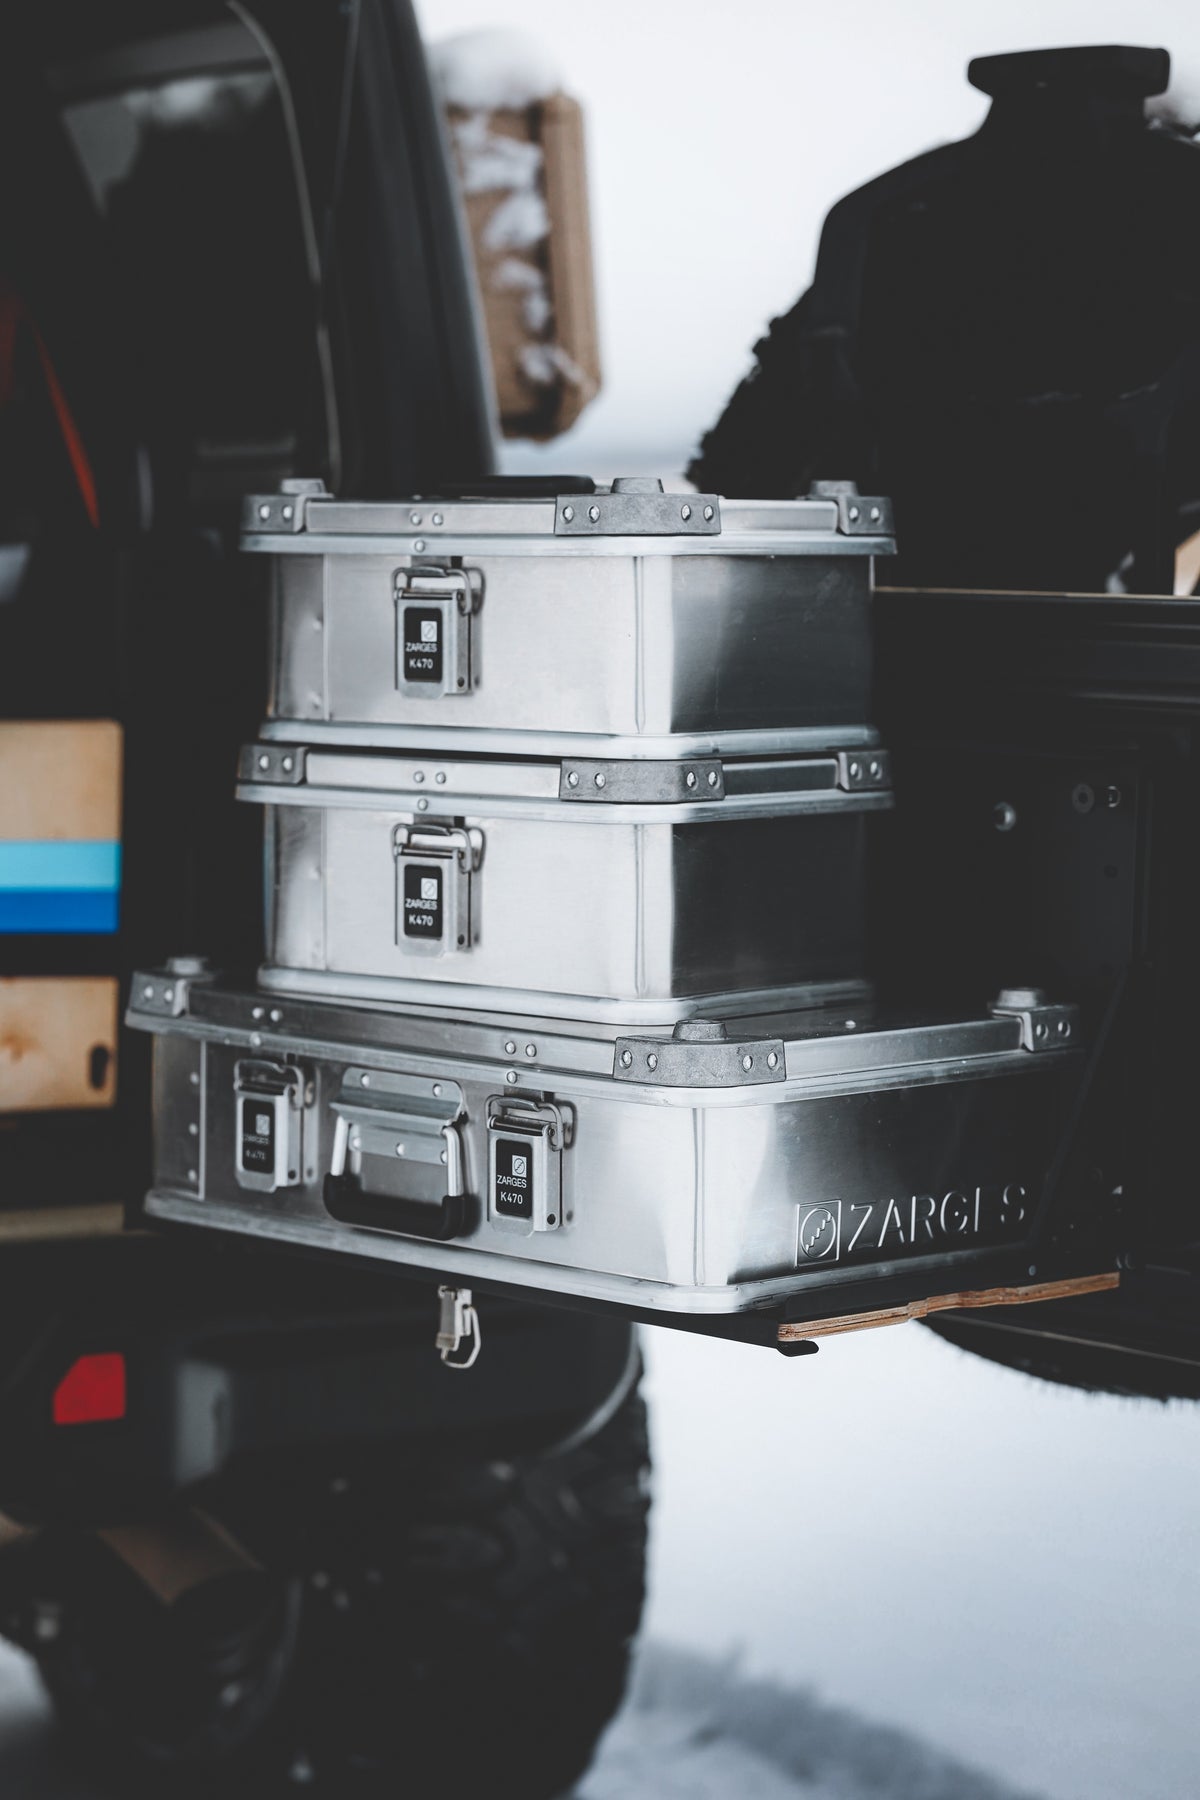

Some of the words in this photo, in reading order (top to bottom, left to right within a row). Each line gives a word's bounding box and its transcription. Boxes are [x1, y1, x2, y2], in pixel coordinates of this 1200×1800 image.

[405, 642, 437, 653] ZARGES
[409, 659, 433, 670] K470
[405, 898, 437, 911] ZARGES
[408, 915, 433, 927] K470
[496, 1174, 527, 1188] ZARGES
[500, 1191, 523, 1205] K470
